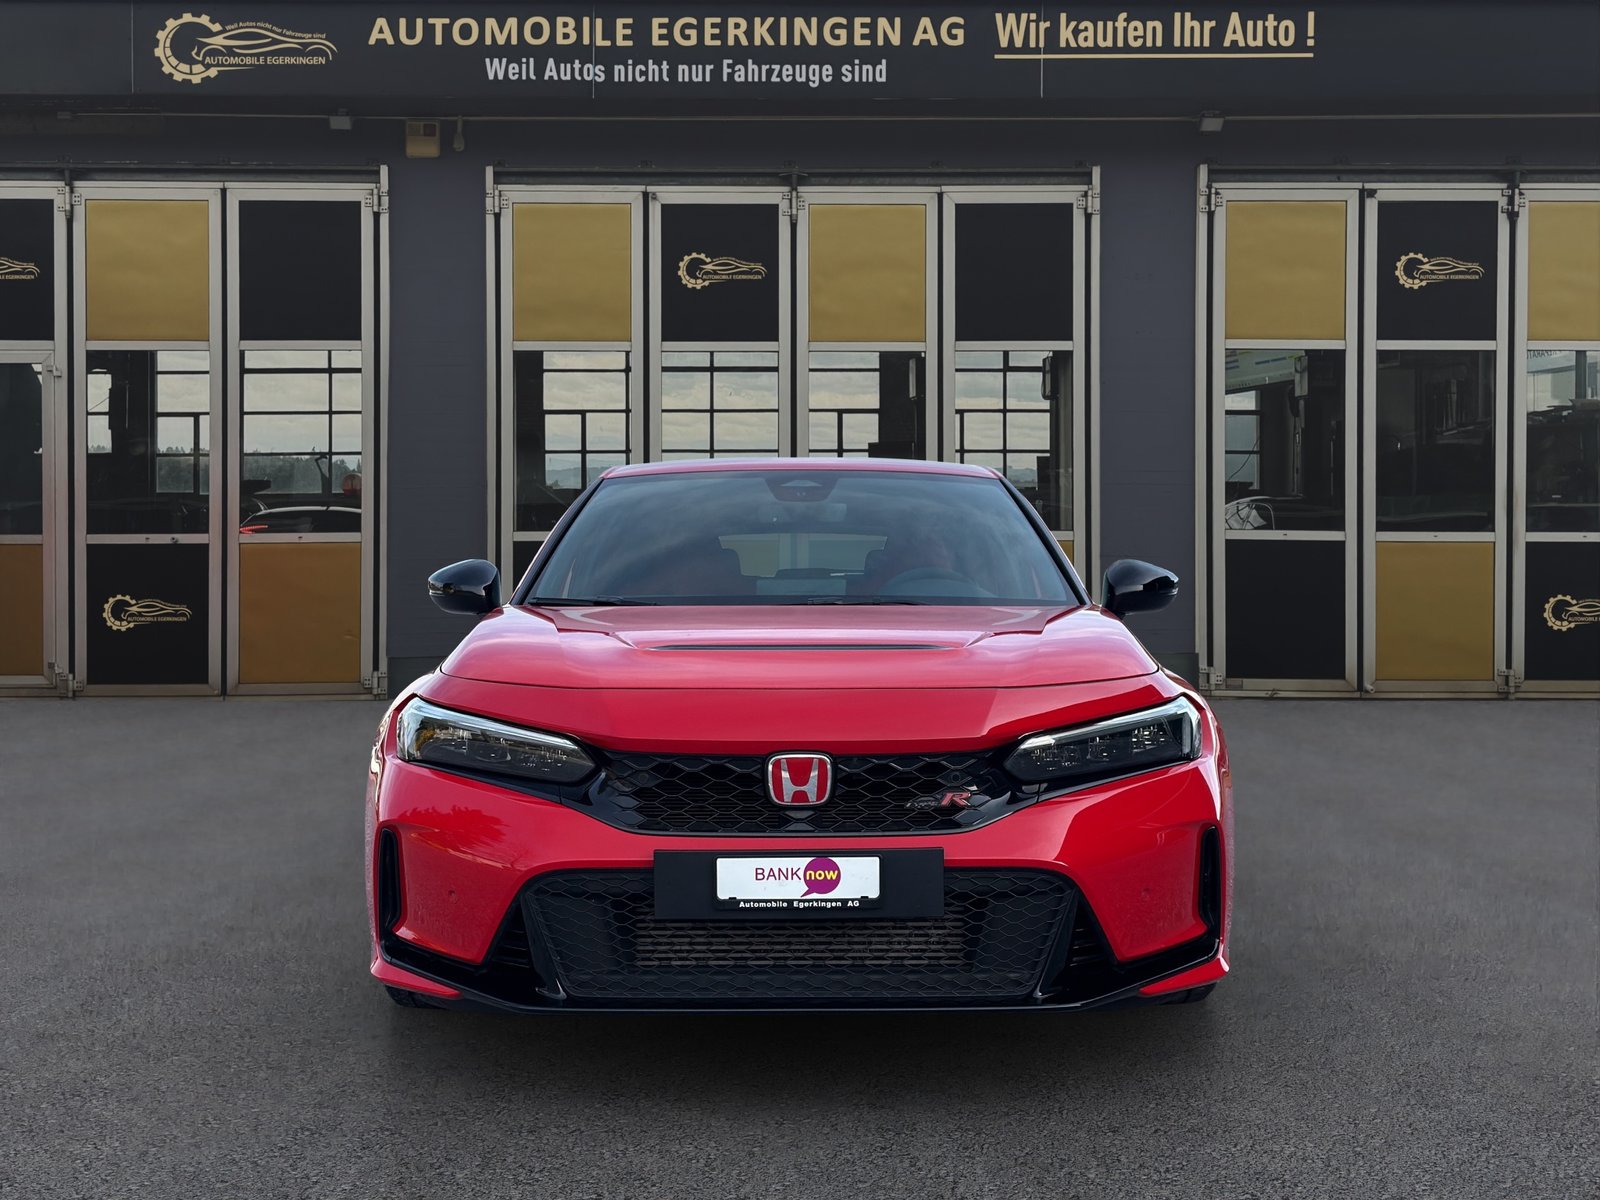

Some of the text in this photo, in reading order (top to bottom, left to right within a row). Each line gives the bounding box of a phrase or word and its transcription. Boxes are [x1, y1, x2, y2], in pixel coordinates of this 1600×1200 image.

[225, 23, 239, 31] Weil
[256, 21, 272, 30] nicht
[282, 29, 312, 39] Fahrzeuge
[368, 16, 965, 47] AUTOMOBILE EGERKINGEN AG
[995, 10, 1315, 48] Wir kaufen Ihr Auto !
[204, 56, 326, 65] AUTOMOBILE EGERKINGEN
[486, 58, 887, 88] Weil Autos nicht nur Fahrzeuge sind
[755, 867, 838, 881] BANK now
[793, 901, 842, 909] Egerkingen
